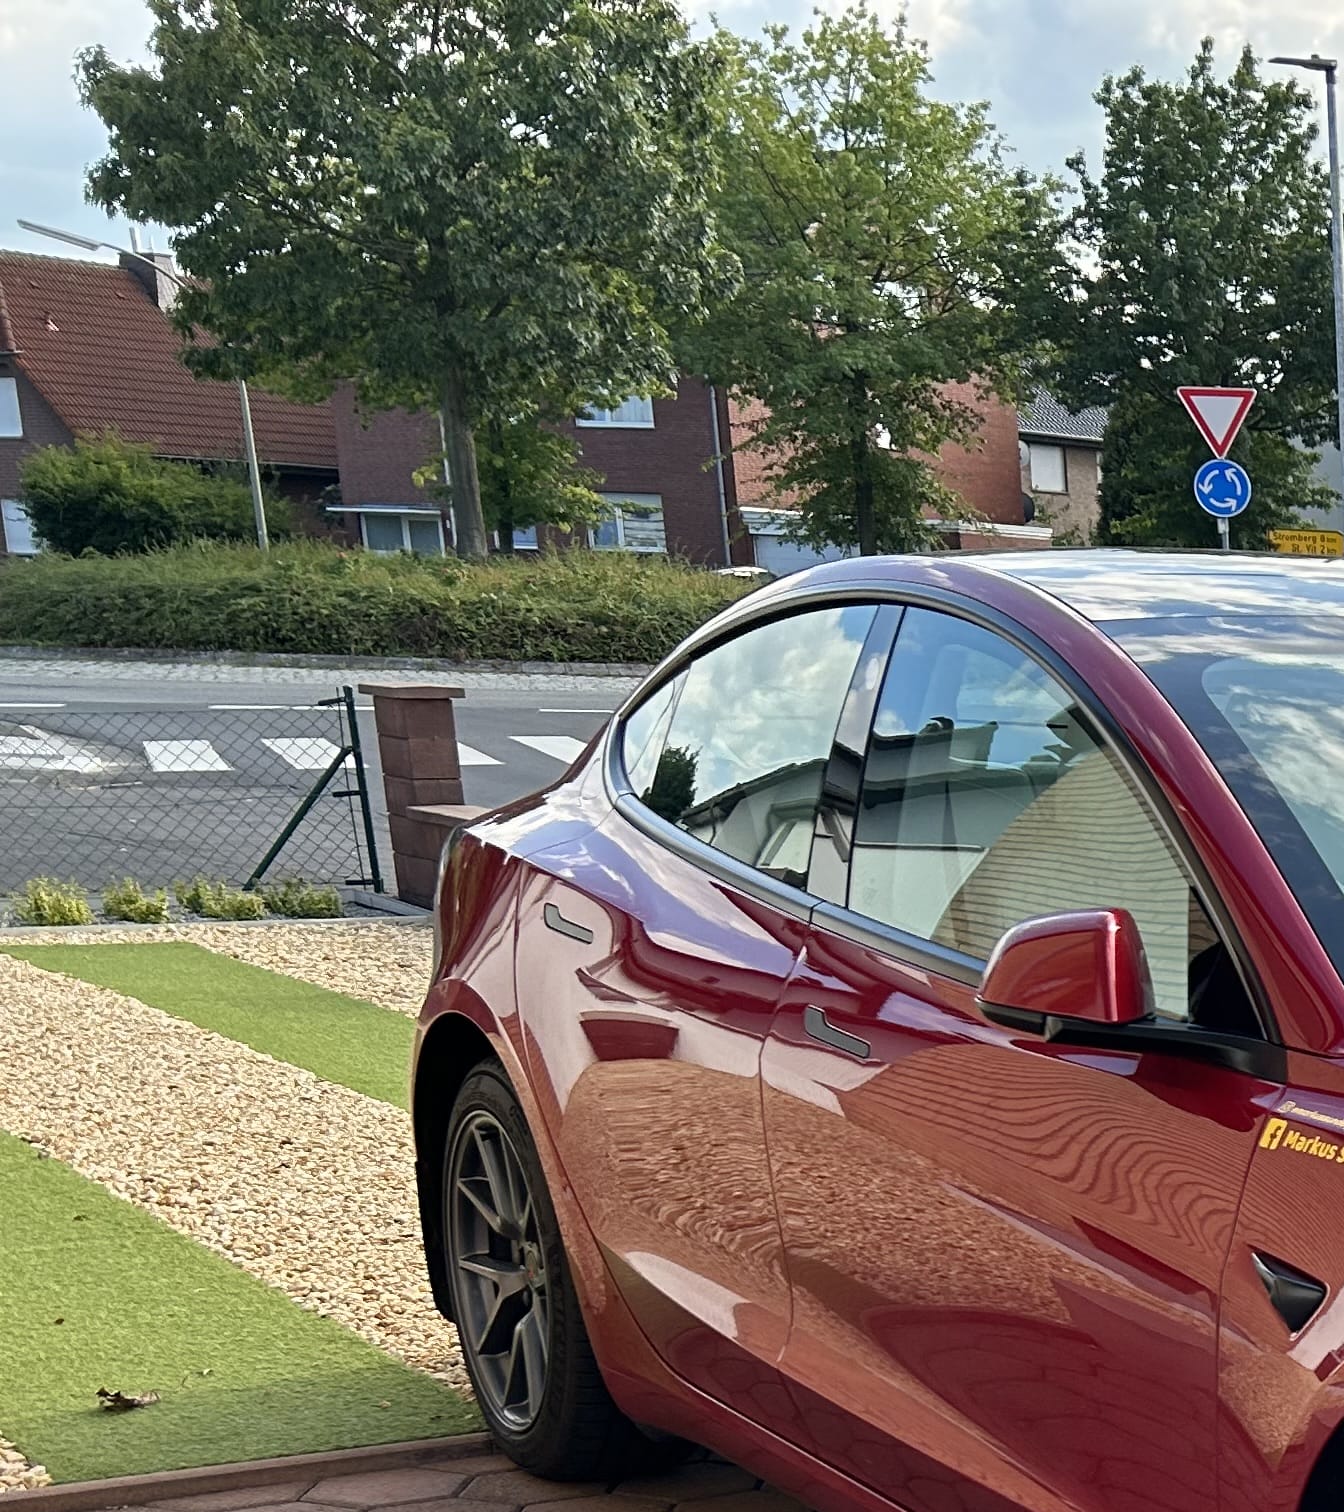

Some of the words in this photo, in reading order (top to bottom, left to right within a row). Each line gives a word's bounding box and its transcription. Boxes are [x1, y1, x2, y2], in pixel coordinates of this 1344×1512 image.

[1273, 532, 1317, 544] Stromberg
[1320, 544, 1325, 553] 2
[1283, 1130, 1339, 1160] Markus
